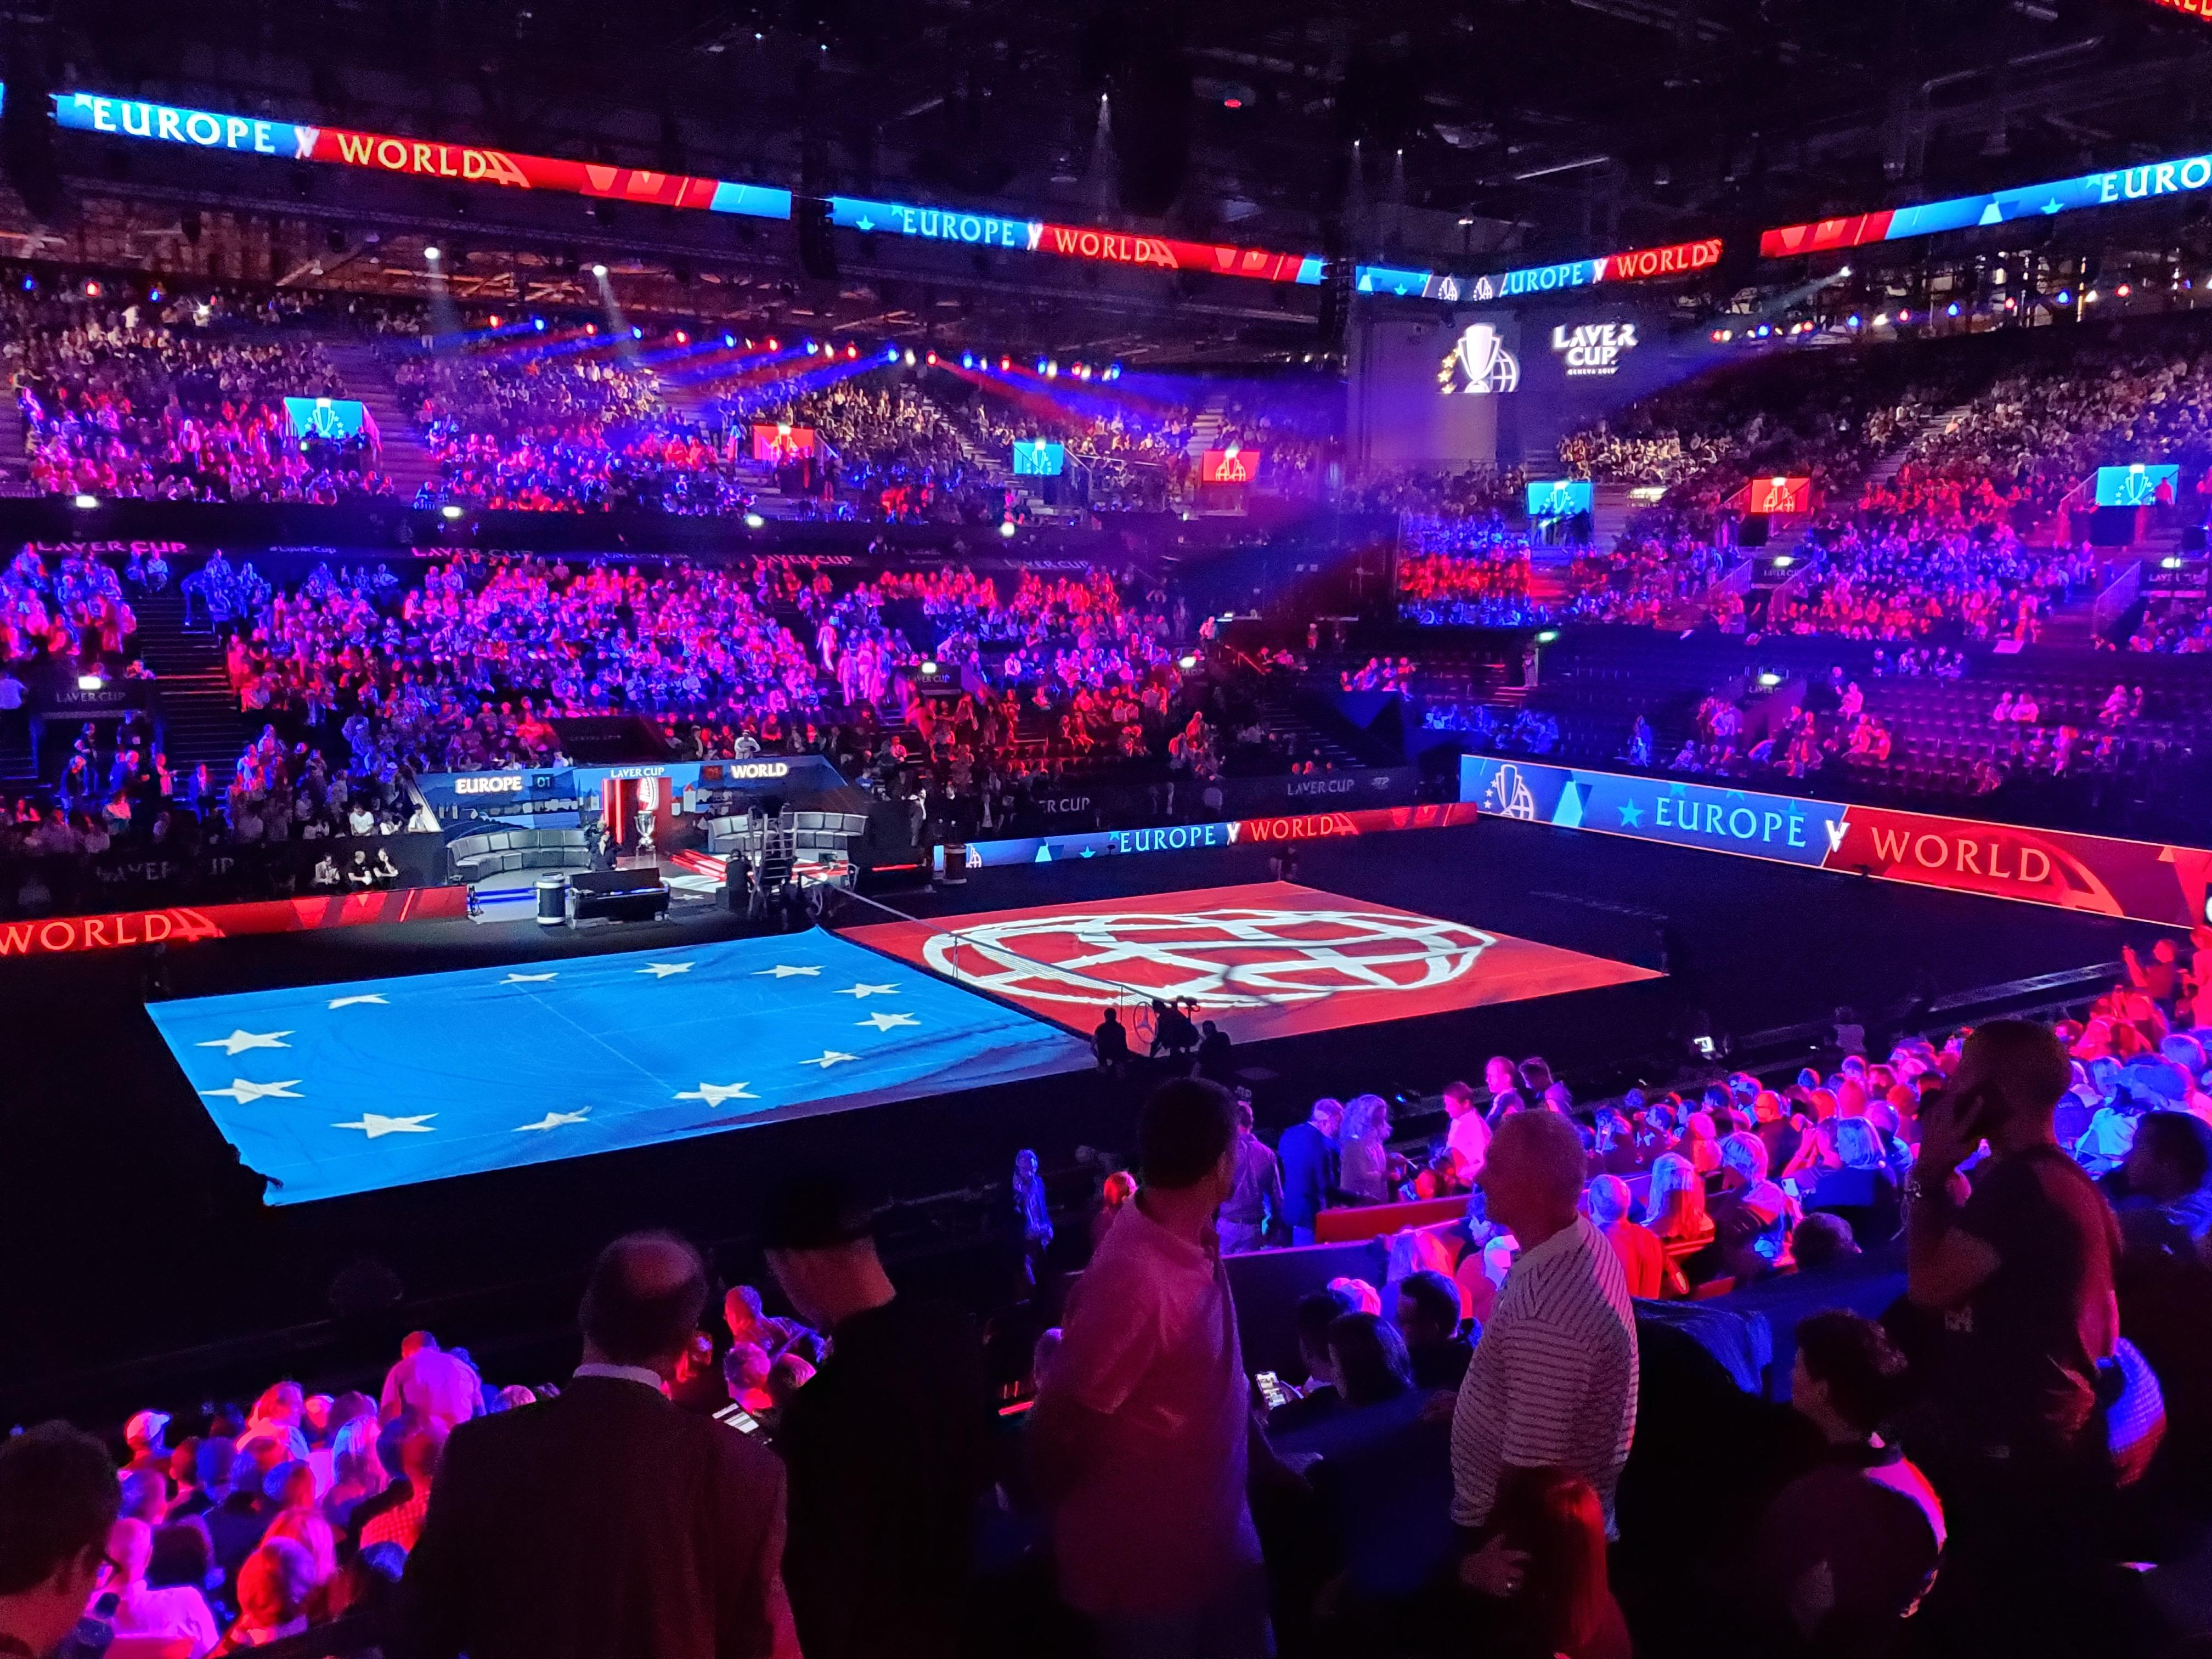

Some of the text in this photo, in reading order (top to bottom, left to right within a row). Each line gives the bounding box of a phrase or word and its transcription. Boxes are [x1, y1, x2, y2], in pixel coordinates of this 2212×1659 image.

[94, 98, 275, 153] EUROPE
[336, 133, 488, 179] WORLD
[2100, 157, 2211, 202] EURO
[902, 209, 1015, 247] EUROPE
[1054, 228, 1151, 262] WORLD
[1616, 245, 1708, 278] WORLD
[1554, 323, 1639, 348] LAVER
[37, 540, 128, 552] LAVER
[815, 555, 852, 565] CUP
[56, 691, 126, 702] LAVER CUP
[611, 767, 665, 778] LAVER CUP
[730, 762, 788, 779] WORLD
[455, 776, 522, 794] EUROPE
[1287, 780, 1326, 796] LAVER
[1328, 778, 1355, 793] CUP
[1059, 797, 1090, 812] CUP
[1120, 825, 1215, 854] EUROPE
[1251, 815, 1334, 842] WORLD
[1656, 797, 1807, 848] EUROPE
[1871, 826, 2051, 882] WORLD
[0, 913, 172, 955] WORLD
